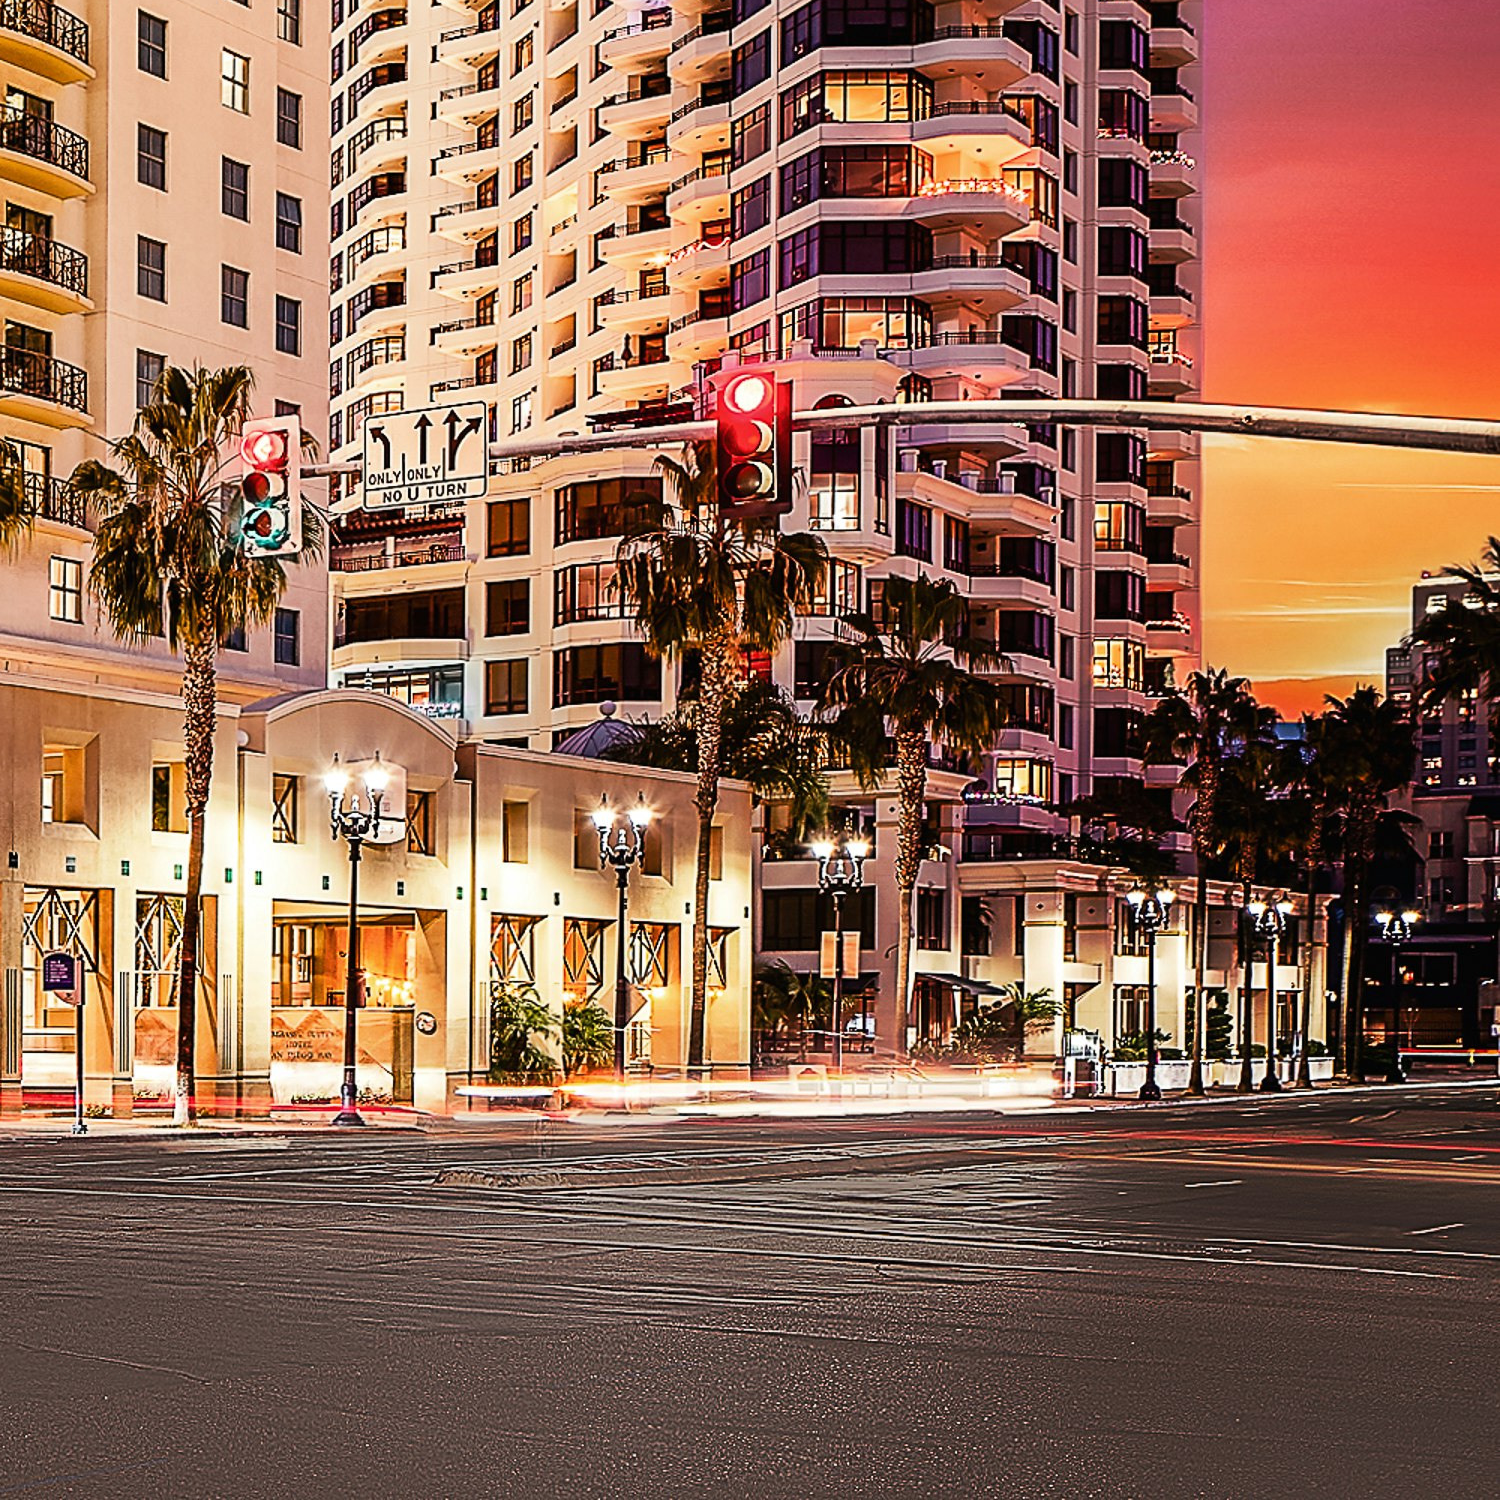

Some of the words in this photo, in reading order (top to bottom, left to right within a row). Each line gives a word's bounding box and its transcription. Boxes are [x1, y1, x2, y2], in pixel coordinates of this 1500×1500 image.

[368, 470, 401, 486] ONLY
[407, 465, 441, 481] ONLY
[383, 490, 402, 503] NO
[407, 487, 419, 501] U
[426, 483, 467, 499] TURN
